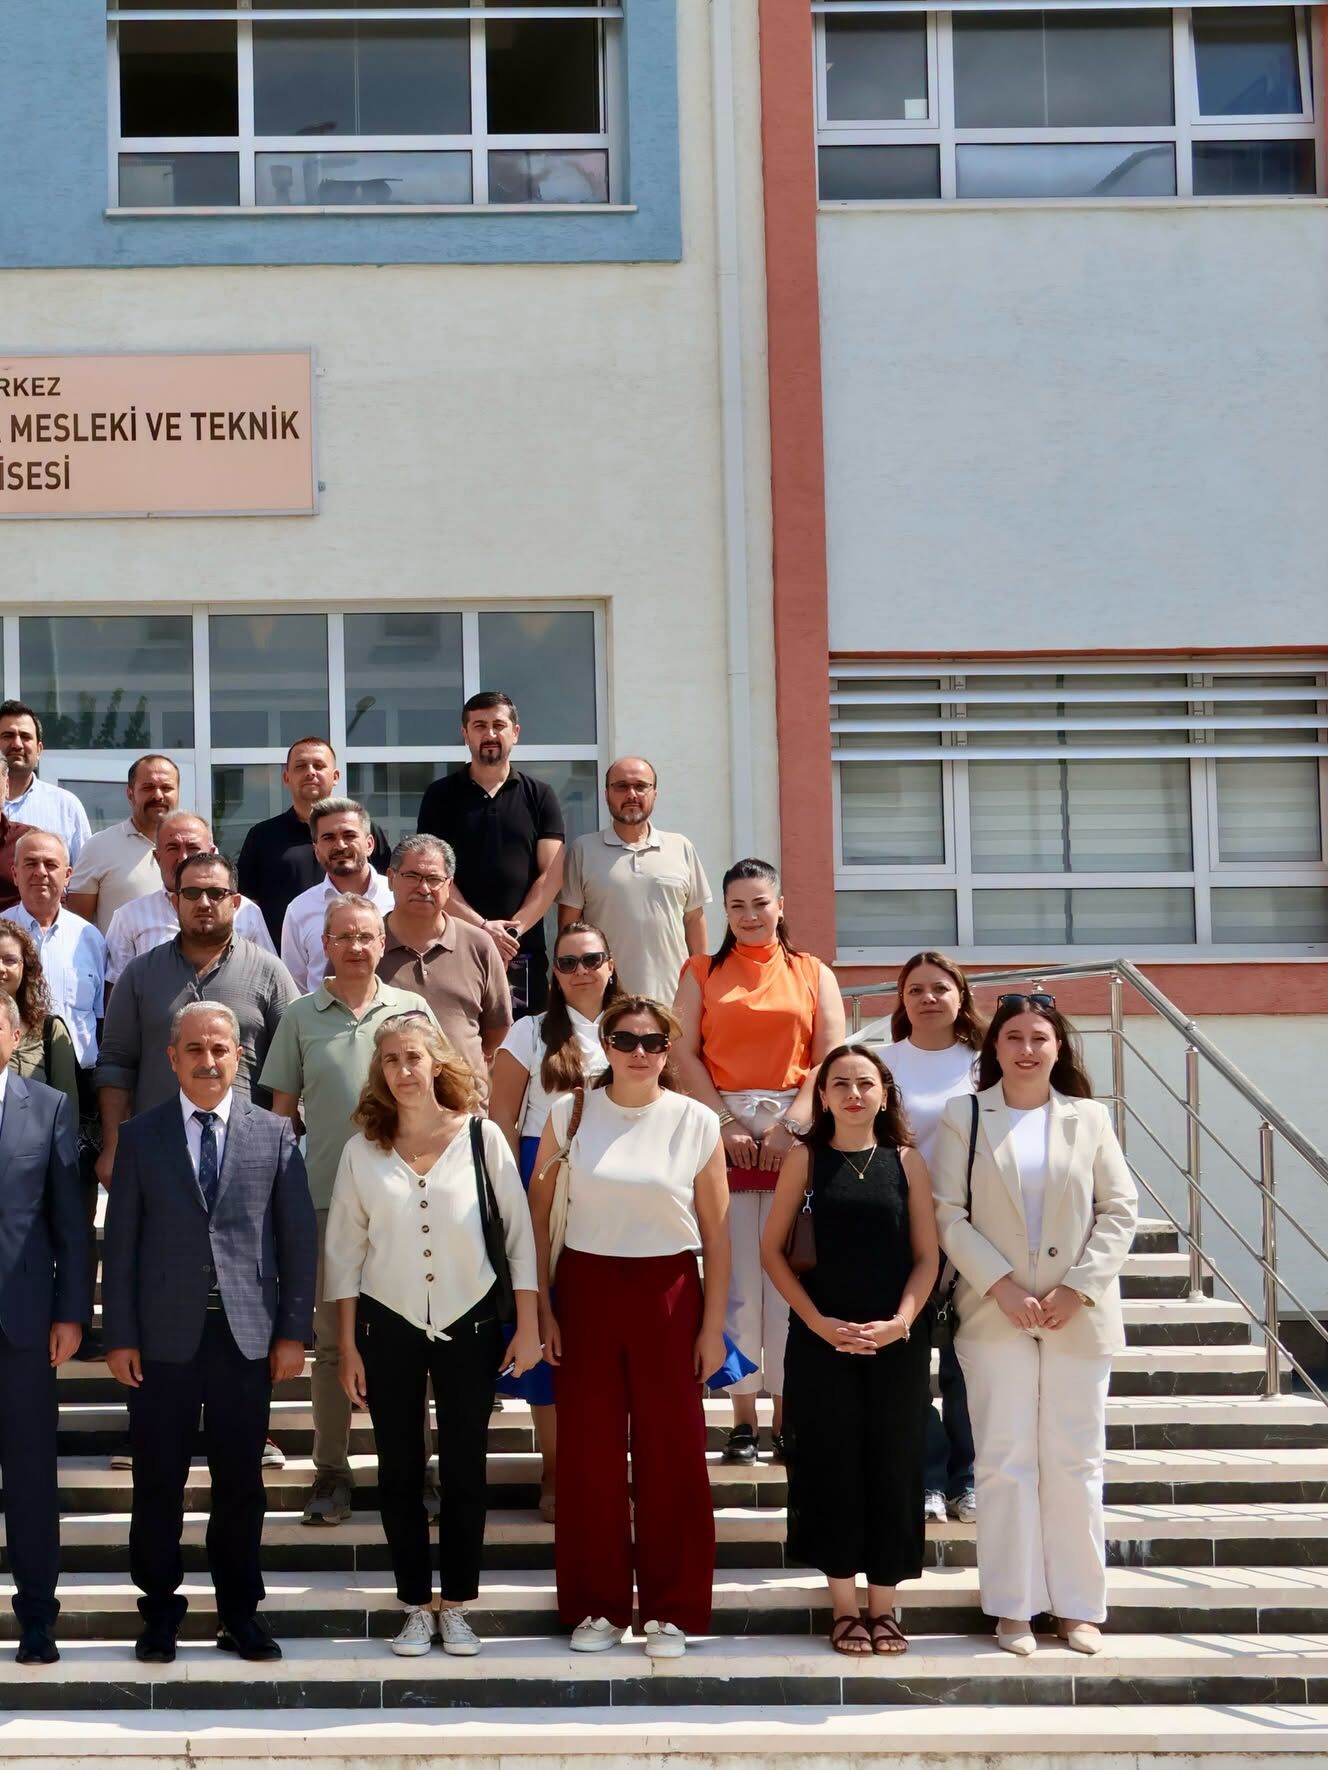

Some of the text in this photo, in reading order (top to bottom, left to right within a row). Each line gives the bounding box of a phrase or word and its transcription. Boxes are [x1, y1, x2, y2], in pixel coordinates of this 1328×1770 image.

[10, 405, 138, 443] MESLEKİ
[145, 411, 183, 441] VE
[189, 404, 301, 441] TEKNİK
